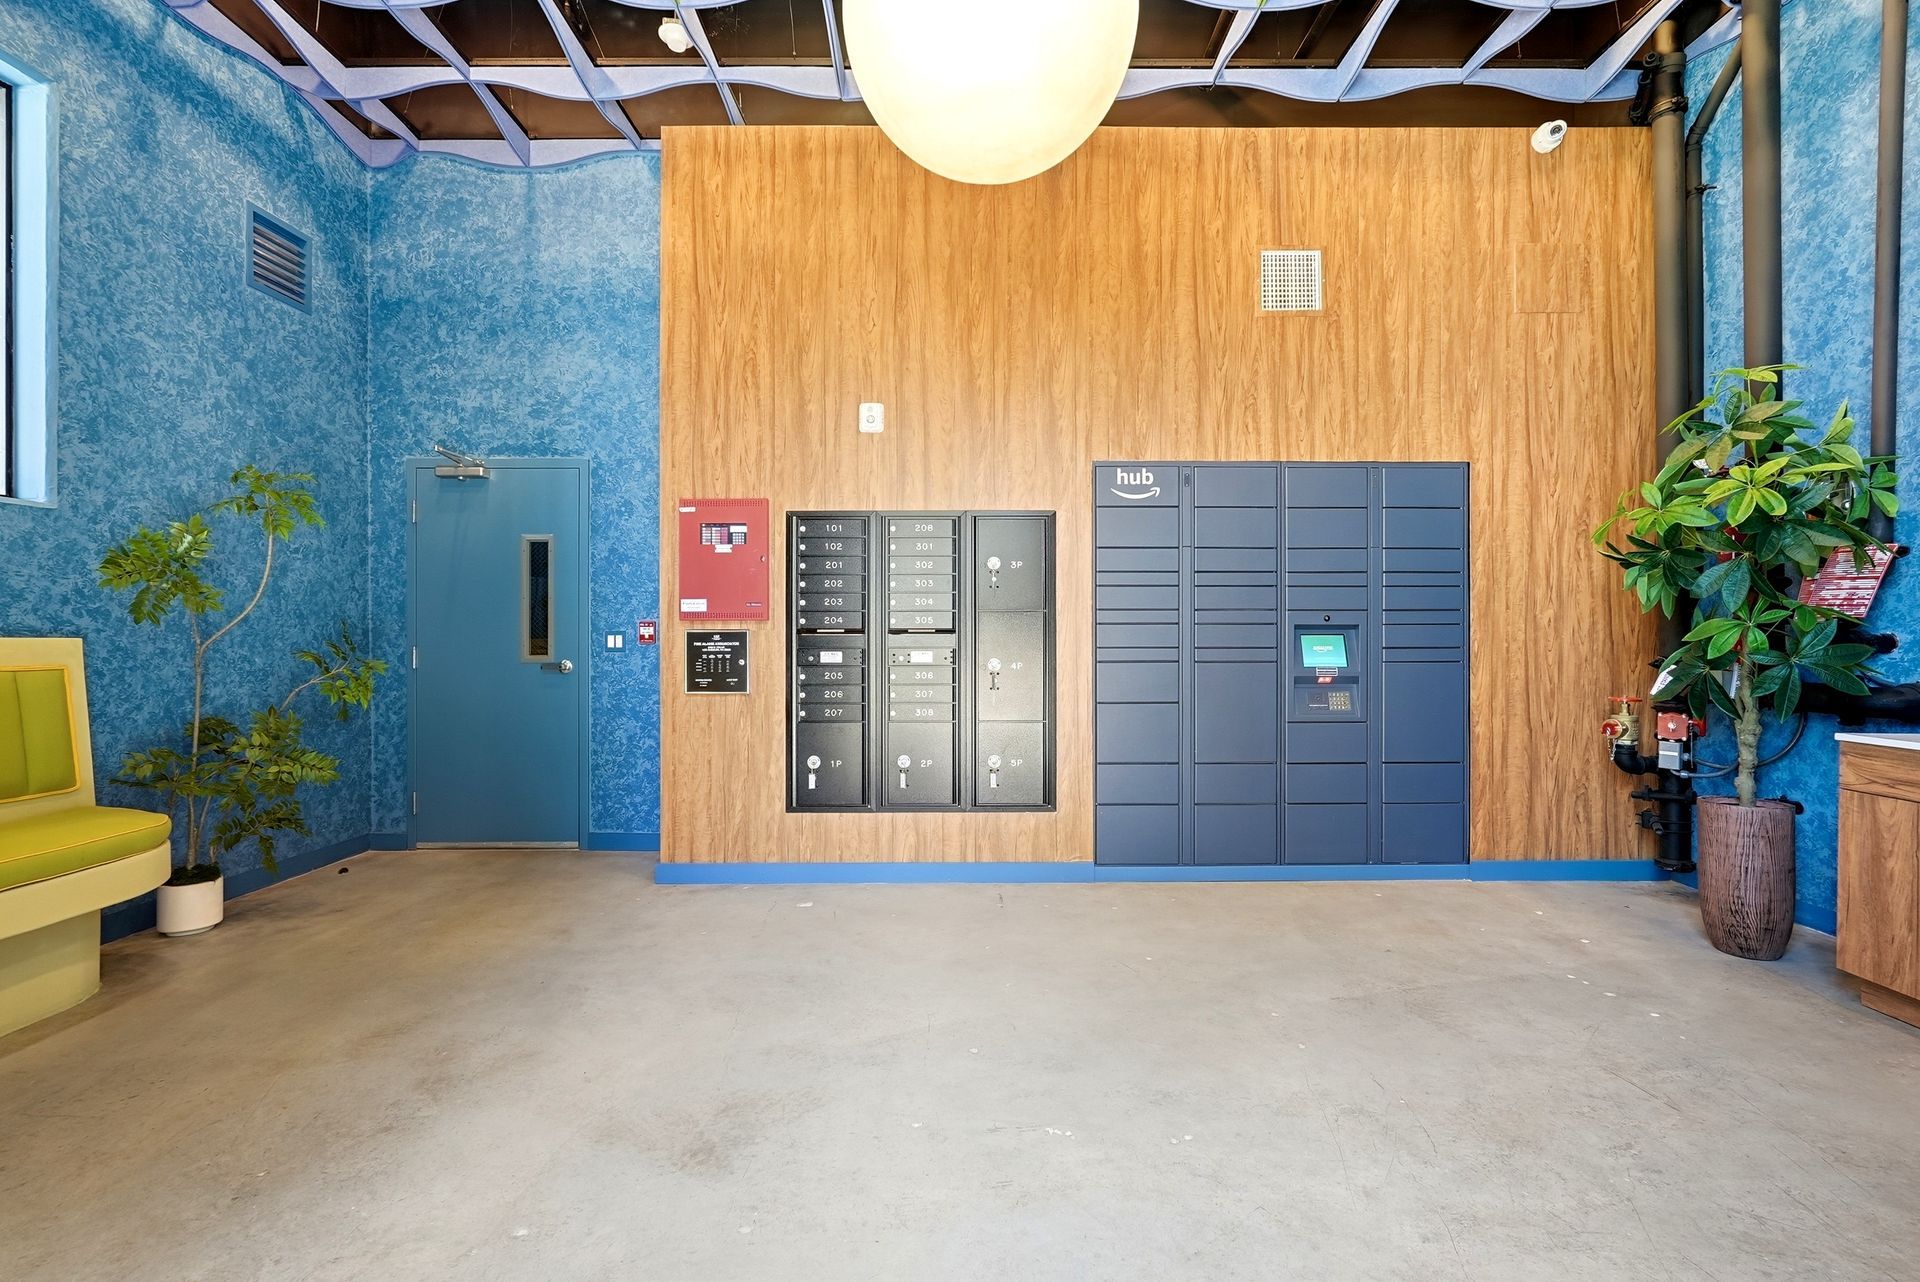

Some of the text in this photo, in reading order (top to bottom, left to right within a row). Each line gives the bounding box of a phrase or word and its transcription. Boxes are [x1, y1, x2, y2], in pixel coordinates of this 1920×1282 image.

[1116, 467, 1154, 485] hub
[826, 524, 842, 532] 101
[914, 524, 934, 532] 208
[825, 542, 843, 551] 102
[915, 542, 933, 551] 301
[825, 560, 843, 570] 201
[914, 560, 933, 569] 302
[1010, 560, 1023, 569] 3P
[824, 579, 843, 588] 202
[914, 579, 934, 588] 303
[824, 597, 843, 606] 203
[914, 597, 933, 606] 304
[824, 616, 843, 624] 204
[914, 616, 934, 624] 305
[1010, 662, 1023, 670] 4P
[824, 671, 844, 680] 205
[914, 671, 934, 680] 306
[824, 690, 844, 698] 206
[914, 690, 933, 698] 307
[824, 708, 843, 717] 207
[915, 708, 934, 717] 308
[830, 759, 842, 768] 1P
[920, 759, 933, 768] 2P
[1010, 758, 1023, 767] 5P
